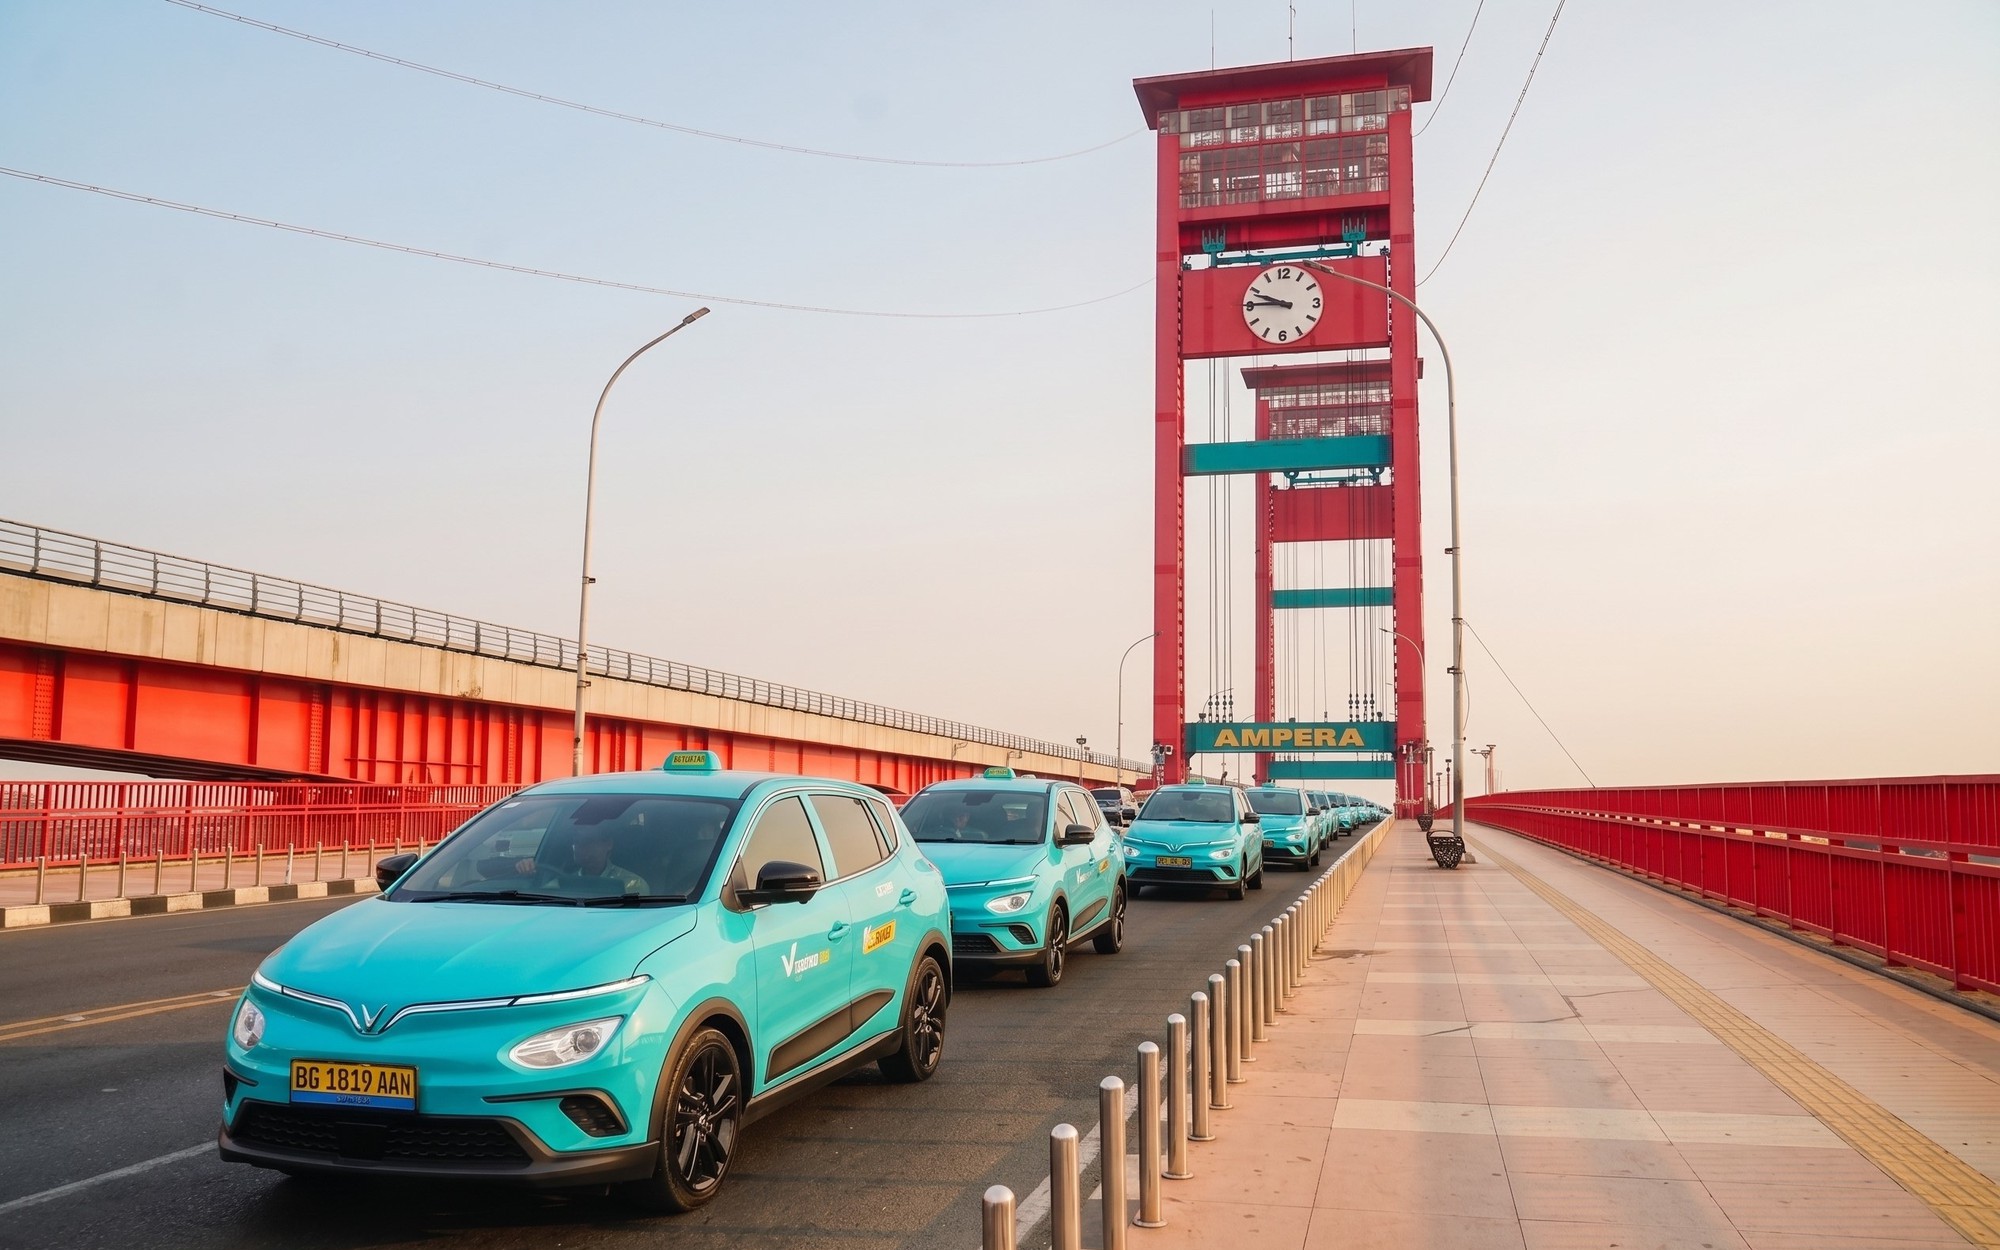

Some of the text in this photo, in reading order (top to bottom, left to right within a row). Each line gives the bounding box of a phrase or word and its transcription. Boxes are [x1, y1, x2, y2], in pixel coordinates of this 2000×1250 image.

[1278, 268, 1290, 279] 12
[1246, 301, 1254, 311] 9
[1312, 298, 1321, 308] 3
[1278, 331, 1287, 341] 6
[1214, 728, 1365, 747] AMPERA
[295, 1066, 411, 1095] BG 1819 AAN
